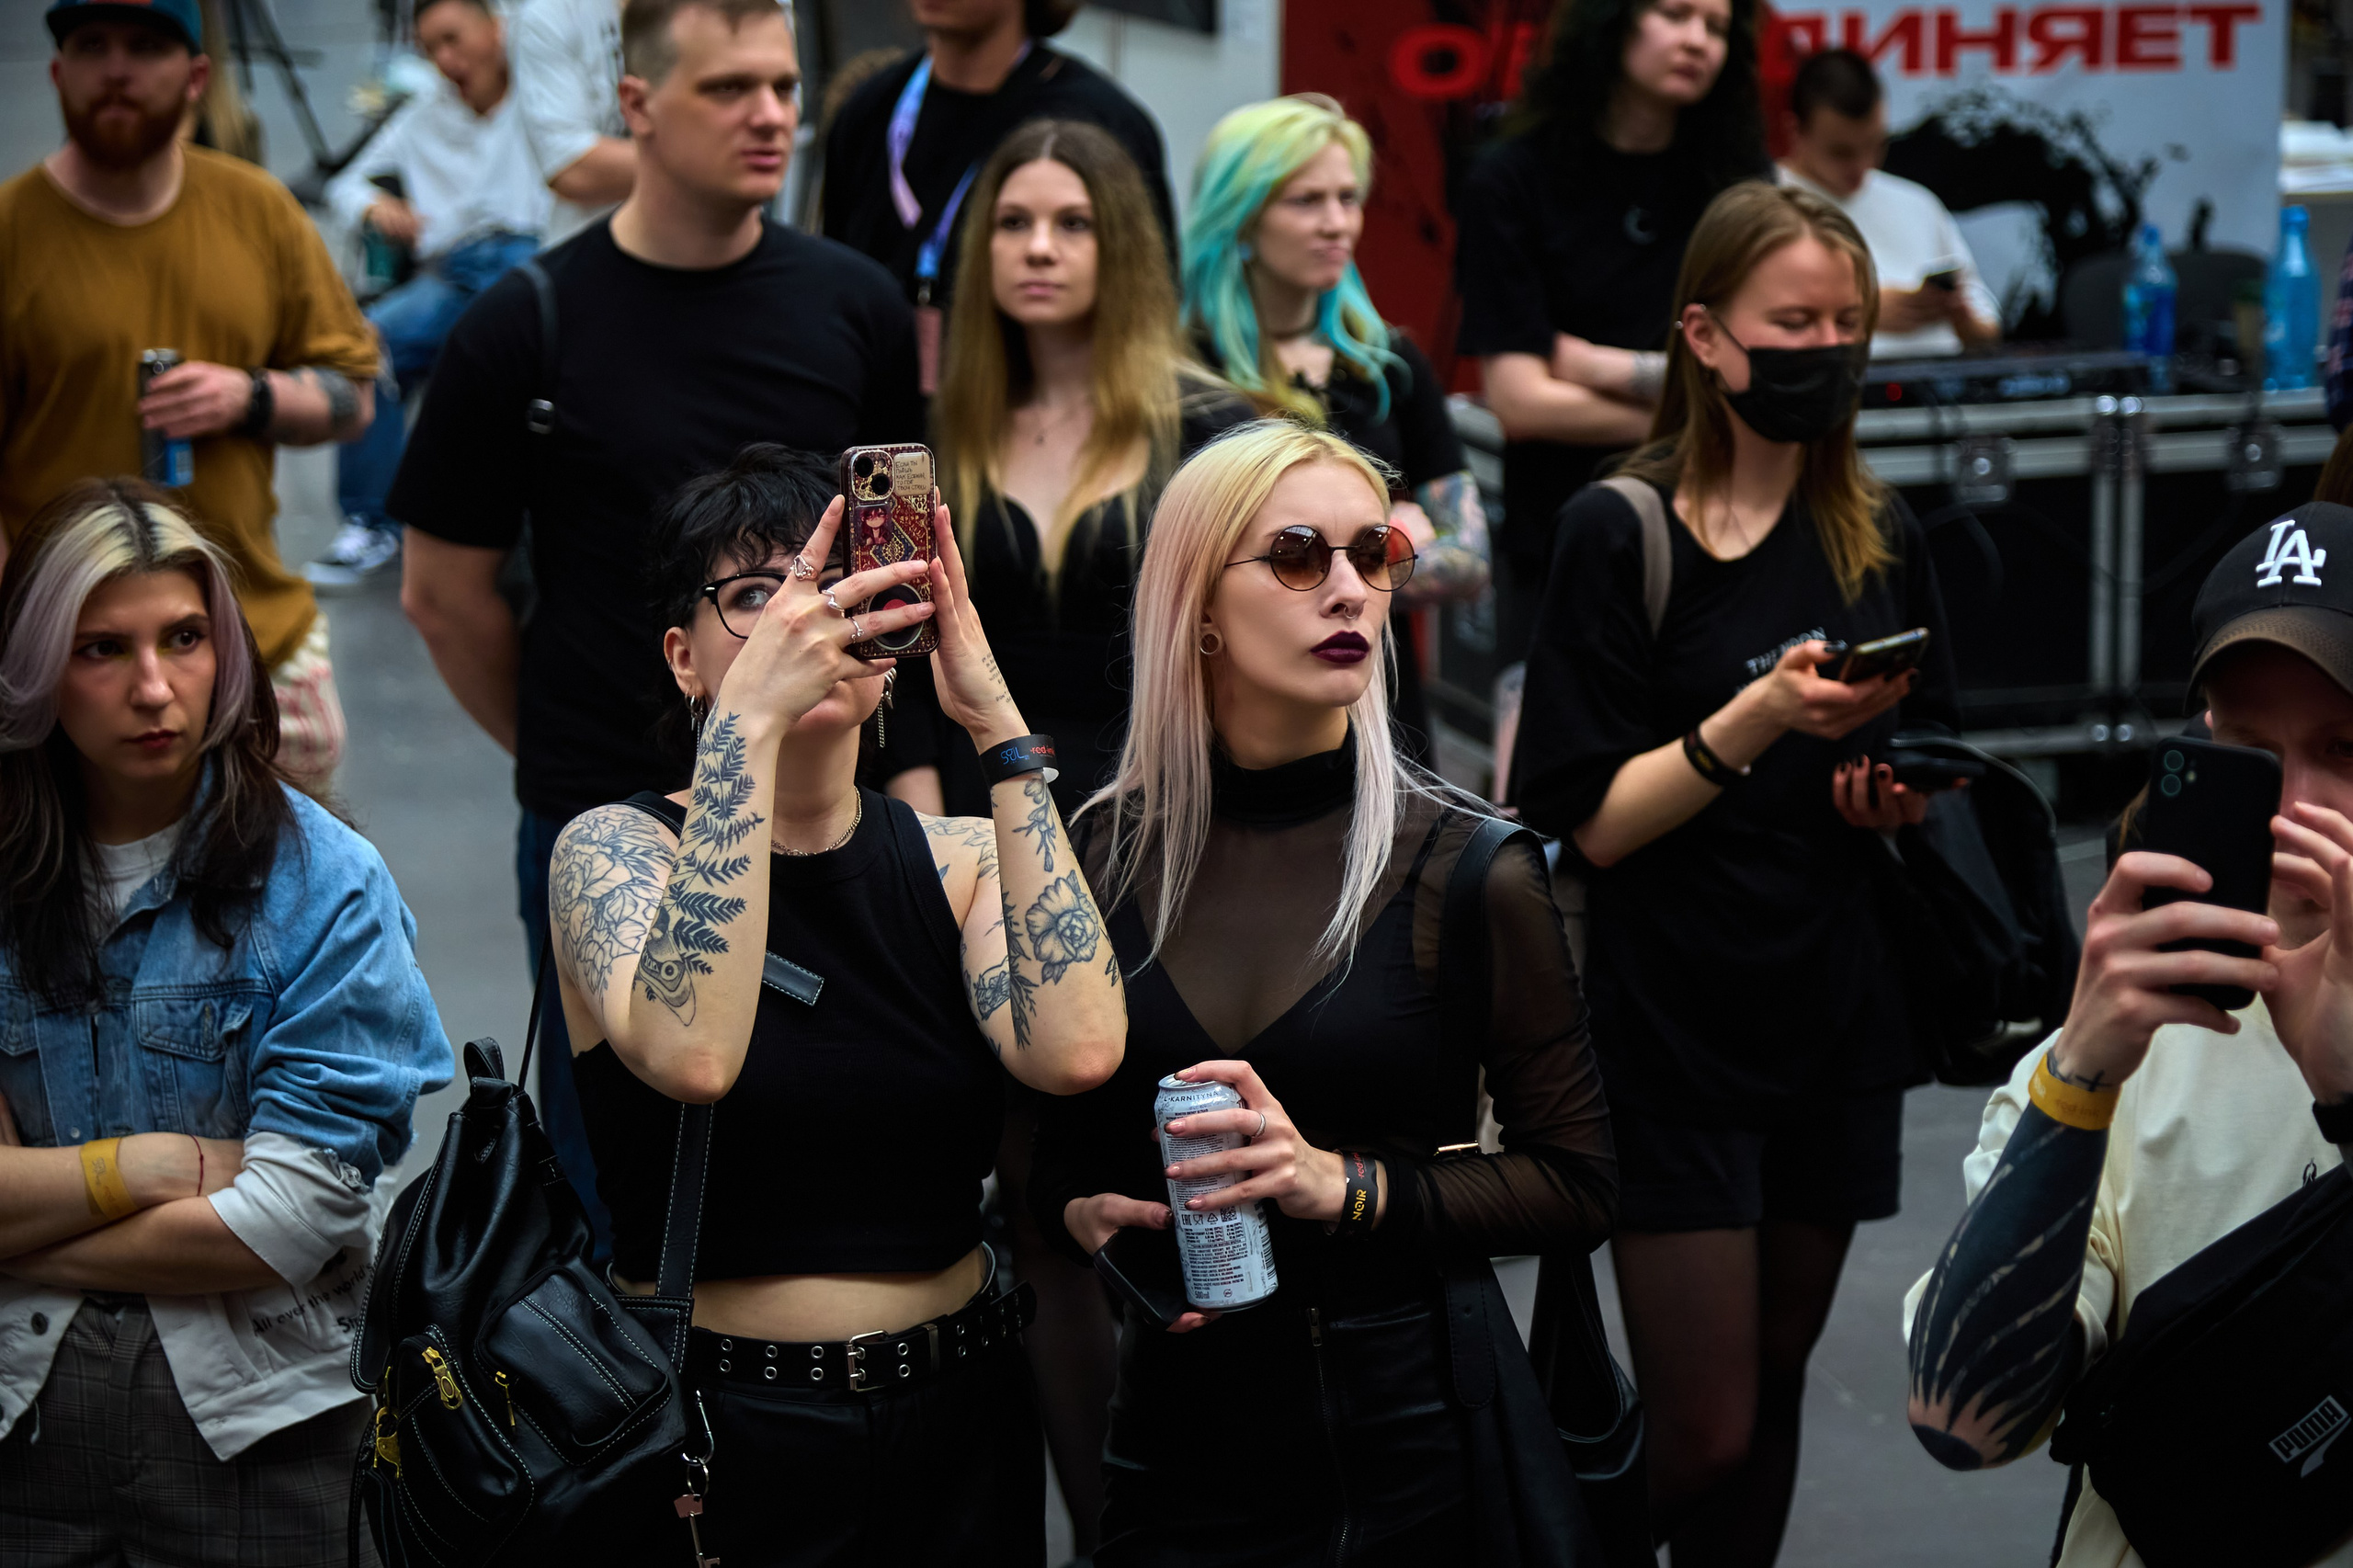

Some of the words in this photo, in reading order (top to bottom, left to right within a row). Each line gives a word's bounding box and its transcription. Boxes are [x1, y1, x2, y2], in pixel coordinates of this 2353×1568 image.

[2256, 519, 2327, 588] LA
[1352, 1188, 1367, 1221] NOIR
[253, 1317, 273, 1337] All
[278, 1303, 307, 1324] over
[308, 1293, 331, 1309] the
[2270, 1396, 2347, 1462] PUMA
